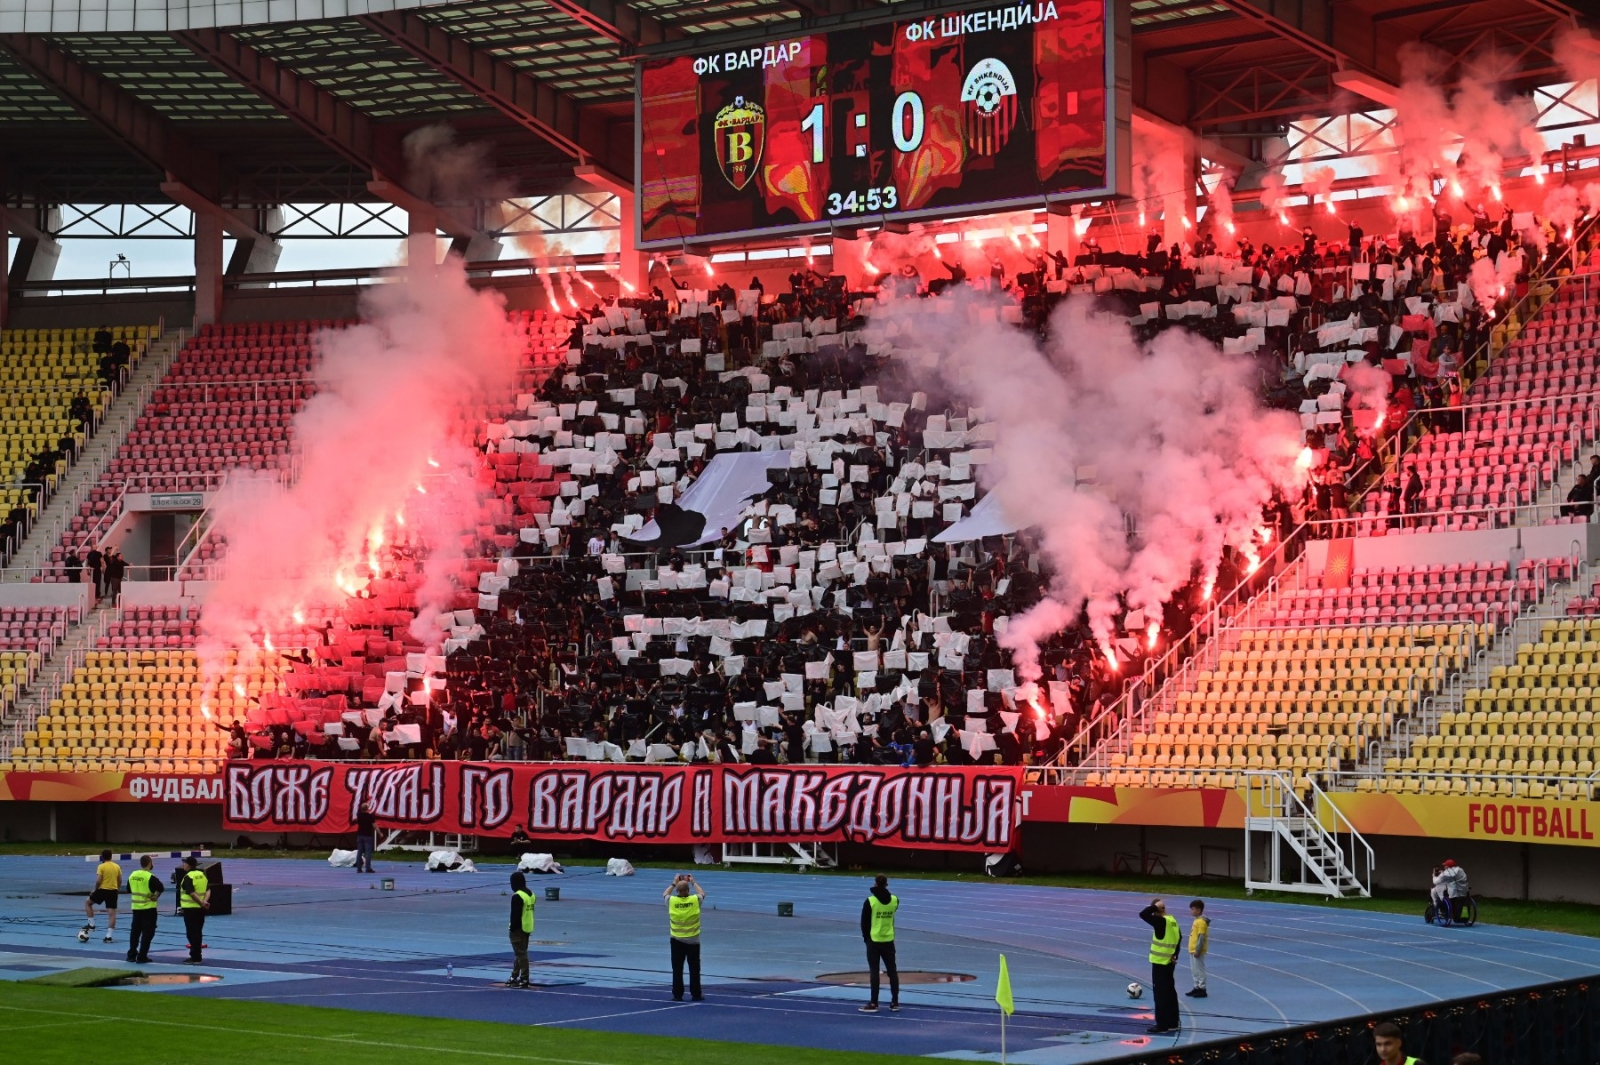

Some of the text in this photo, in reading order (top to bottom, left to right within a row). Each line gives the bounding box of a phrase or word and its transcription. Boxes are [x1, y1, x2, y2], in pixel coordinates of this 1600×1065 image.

[906, 1, 1059, 41] ФК ШКЕНДИЈА
[693, 42, 802, 75] ФК ВАРДАР
[827, 186, 898, 215] 34:53
[226, 764, 333, 825] БОЖЕ
[460, 765, 514, 829] ГО
[530, 770, 684, 838] ВАРДАР
[721, 767, 1015, 845] МАКЕДОНИЈА
[1469, 803, 1594, 840] FOOTBALL
